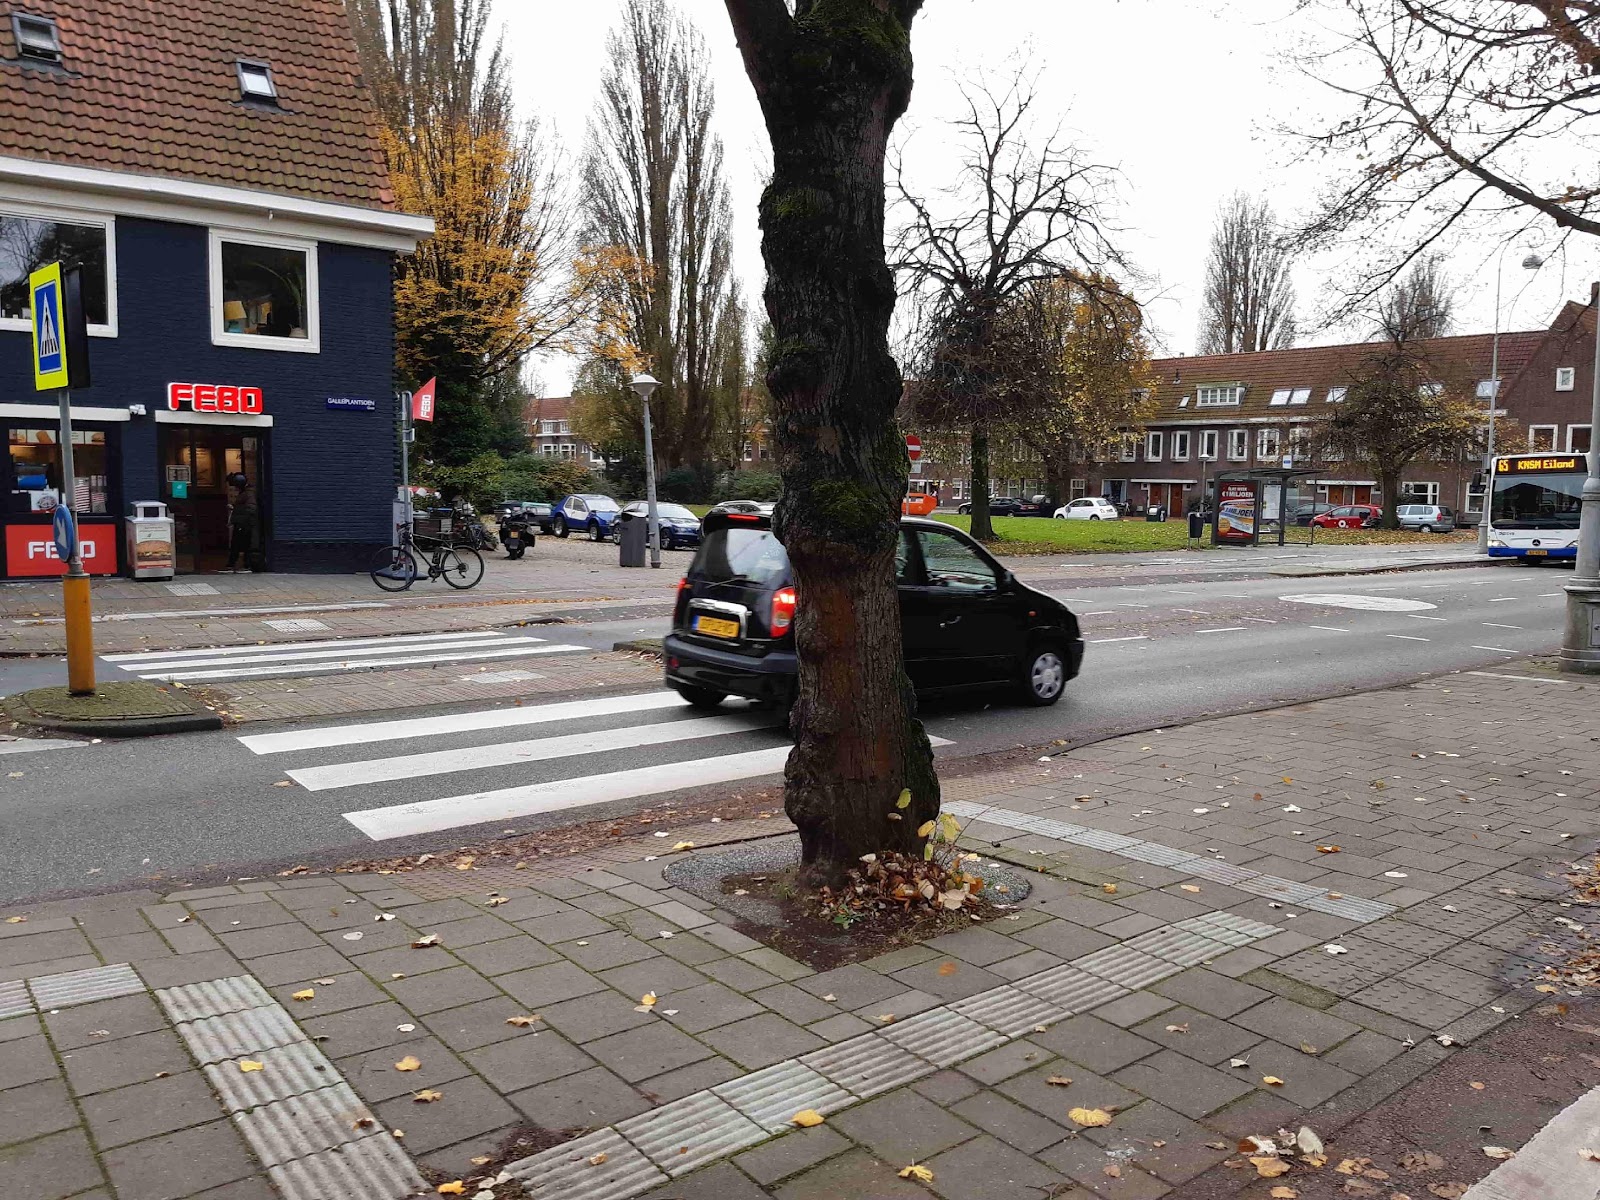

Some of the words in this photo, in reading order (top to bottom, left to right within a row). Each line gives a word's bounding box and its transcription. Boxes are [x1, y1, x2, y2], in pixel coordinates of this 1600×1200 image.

[168, 382, 263, 415] FEBO
[421, 394, 431, 418] FEBO
[1498, 460, 1509, 472] 65
[1517, 460, 1541, 470] KNSM
[1542, 459, 1575, 469] Eiland
[28, 540, 96, 559] FEO
